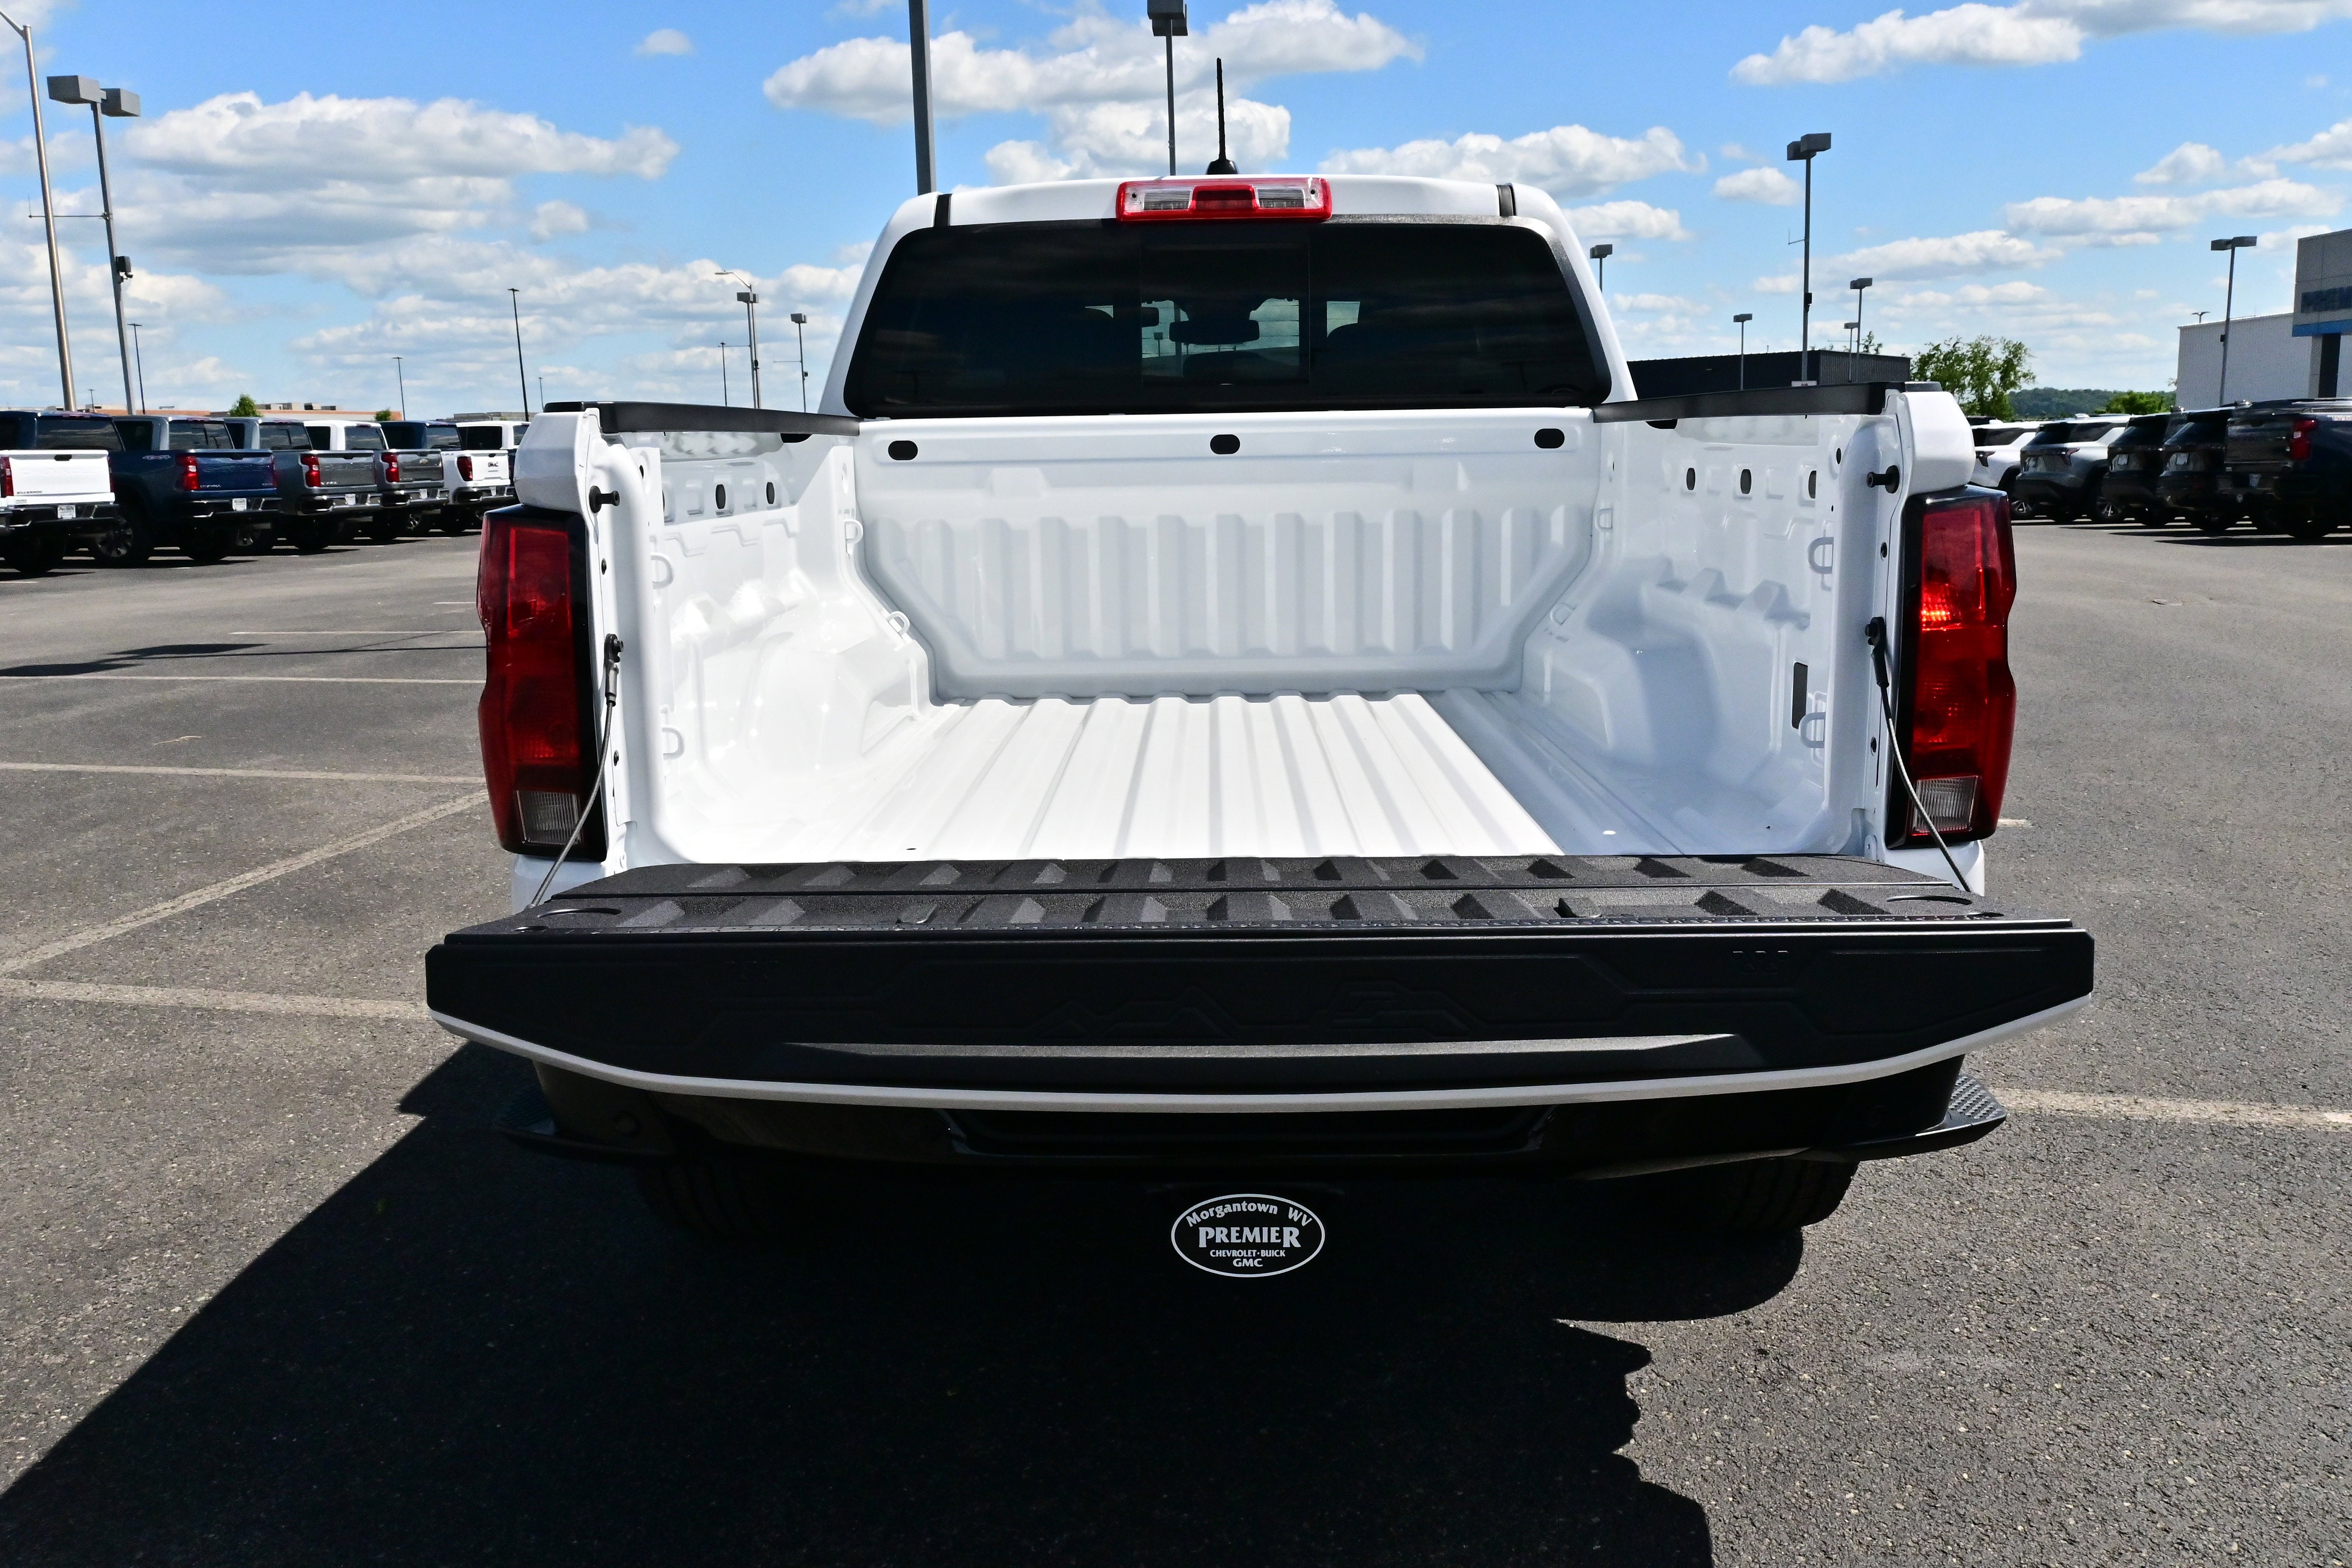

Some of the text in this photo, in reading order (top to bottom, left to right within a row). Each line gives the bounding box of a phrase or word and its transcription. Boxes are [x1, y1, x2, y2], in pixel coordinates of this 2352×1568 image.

[1186, 1200, 1312, 1227] Morgantown WV
[1198, 1227, 1301, 1248] PREMIER
[1233, 1258, 1263, 1267] GMC
